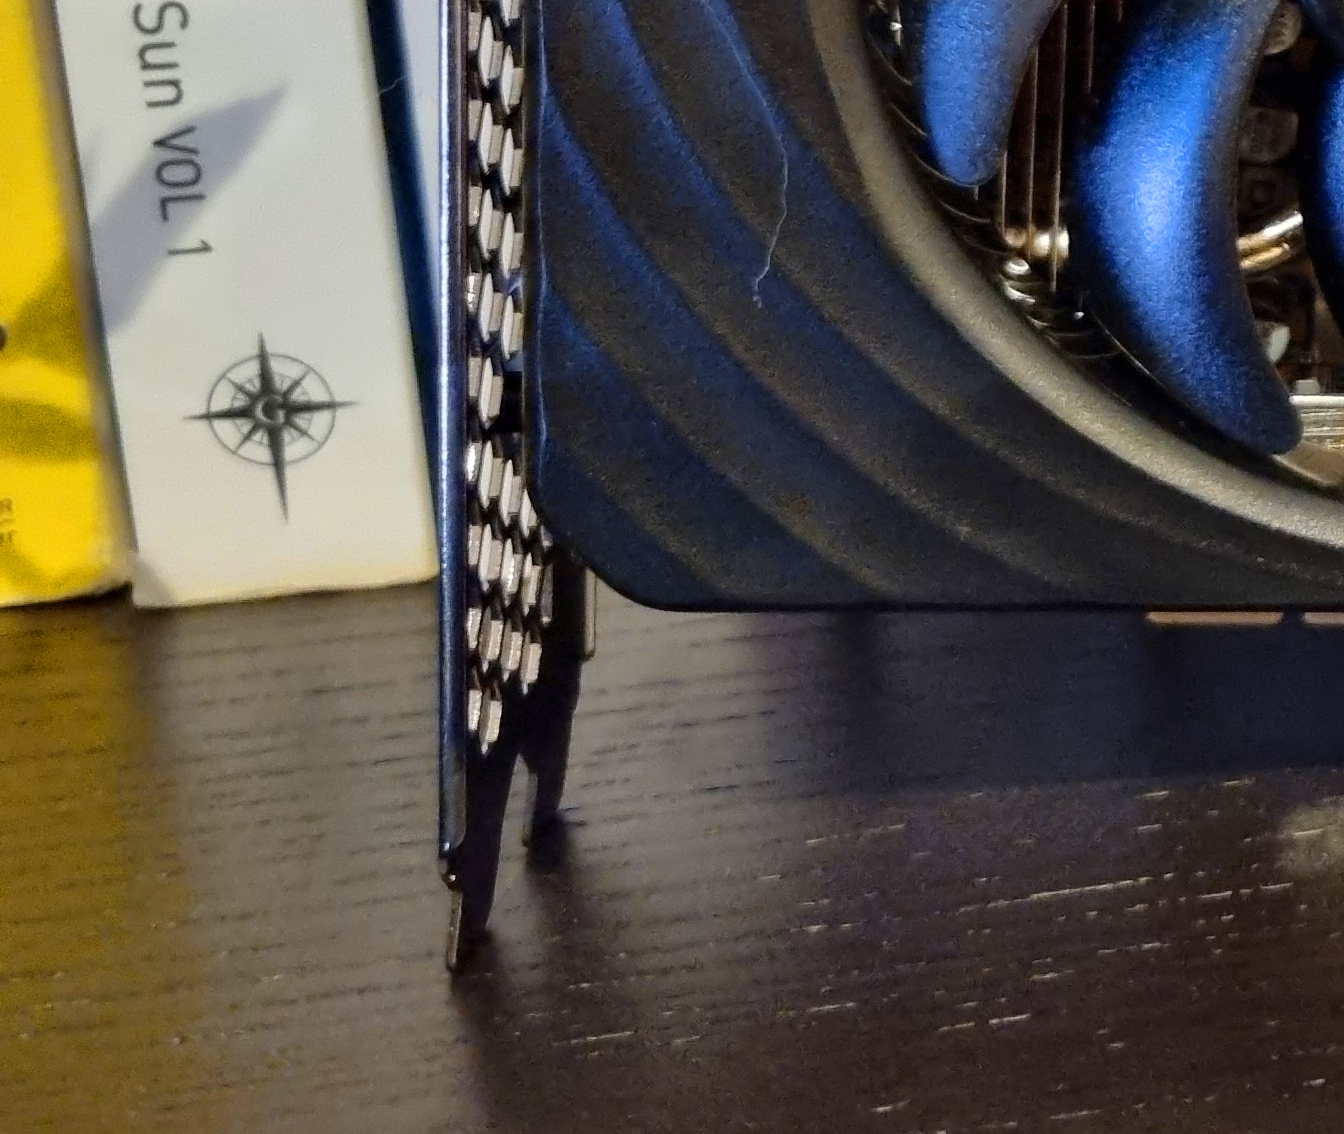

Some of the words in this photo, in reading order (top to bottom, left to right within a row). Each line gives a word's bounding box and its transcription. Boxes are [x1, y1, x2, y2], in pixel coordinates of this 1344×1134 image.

[132, 0, 190, 109] Sun
[151, 124, 206, 222] VOL
[167, 239, 213, 258] 1
